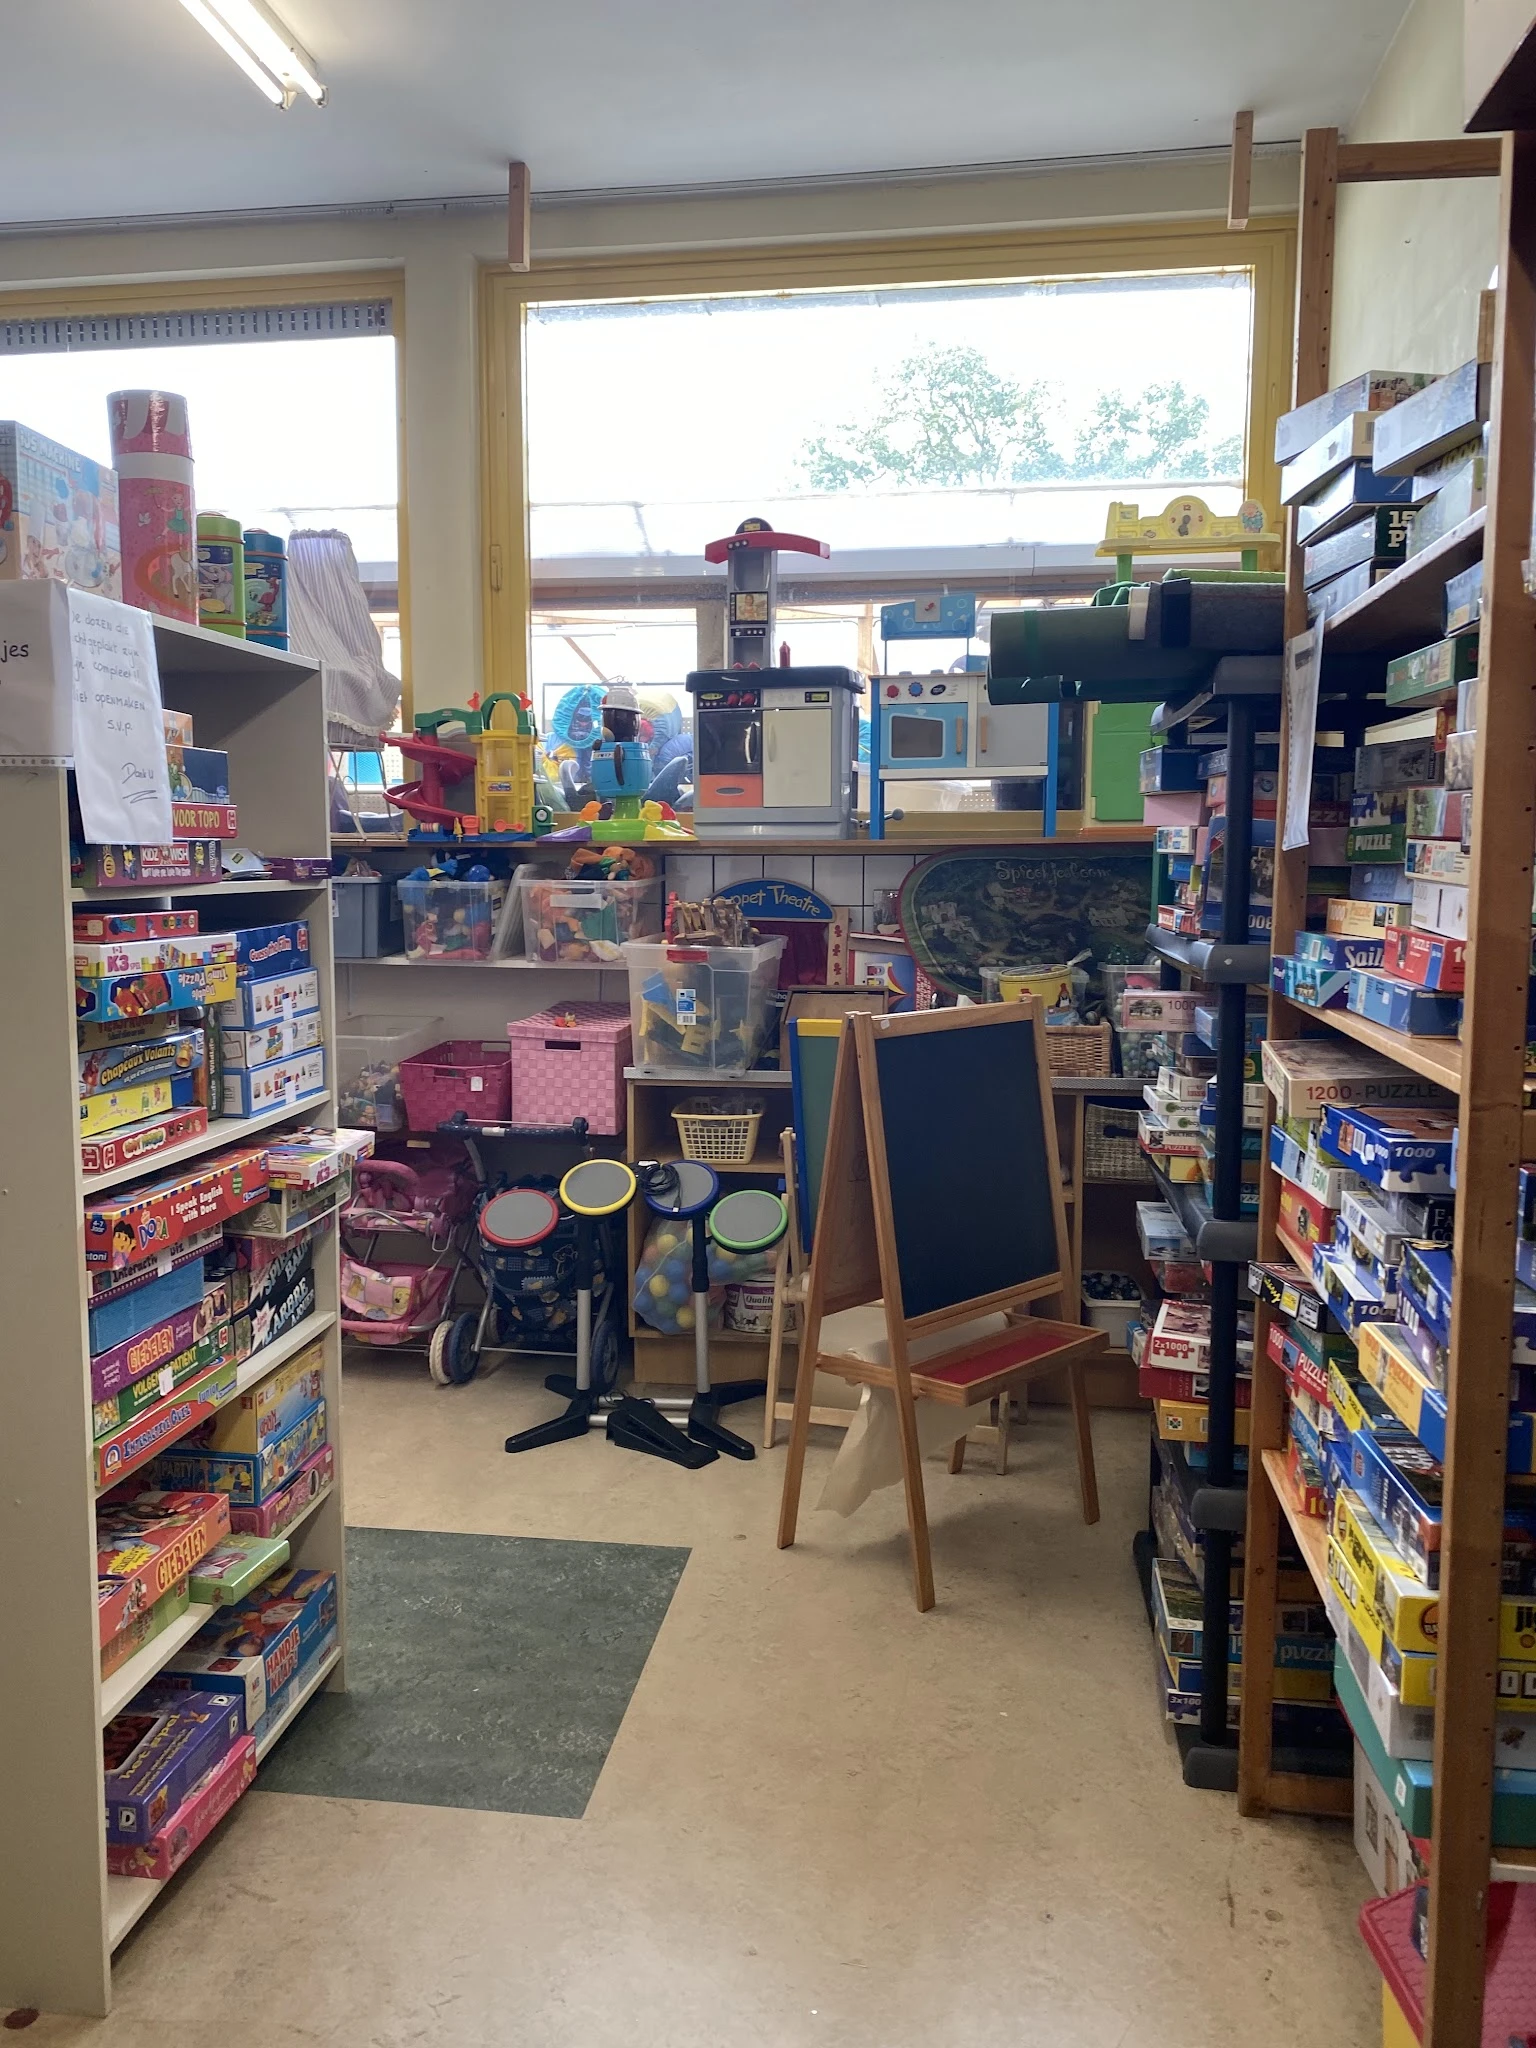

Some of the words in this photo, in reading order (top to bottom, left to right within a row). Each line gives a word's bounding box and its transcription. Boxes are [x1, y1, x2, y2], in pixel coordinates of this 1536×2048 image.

[172, 808, 197, 828] VOOR
[198, 809, 220, 829] TOPO
[1355, 833, 1392, 851] PUZZLE
[141, 847, 160, 862] KIDZ
[170, 846, 188, 861] WISH
[767, 885, 820, 916] Theatre
[1411, 937, 1430, 952] PUZZLE
[107, 955, 129, 973] K3
[178, 972, 206, 988] Puzzle
[1168, 1000, 1196, 1011] 1000
[101, 1054, 144, 1086] Chapeaux
[144, 1044, 177, 1062] Volants
[1306, 1085, 1351, 1100] 1200
[1365, 1083, 1441, 1099] PUZZLE
[1395, 1146, 1436, 1159] 1000
[175, 1196, 198, 1215] Speak
[200, 1184, 223, 1206] English
[182, 1211, 199, 1224] with
[200, 1202, 217, 1216] Dora
[138, 1216, 169, 1250] DORA
[127, 1325, 175, 1375] GIEBELEN
[1154, 1340, 1188, 1351] 2x1000
[1269, 1327, 1284, 1350] 1000
[1298, 1351, 1328, 1389] PUZZLE
[156, 1522, 207, 1593] GIEBELEN
[266, 1624, 300, 1679] HANDJE
